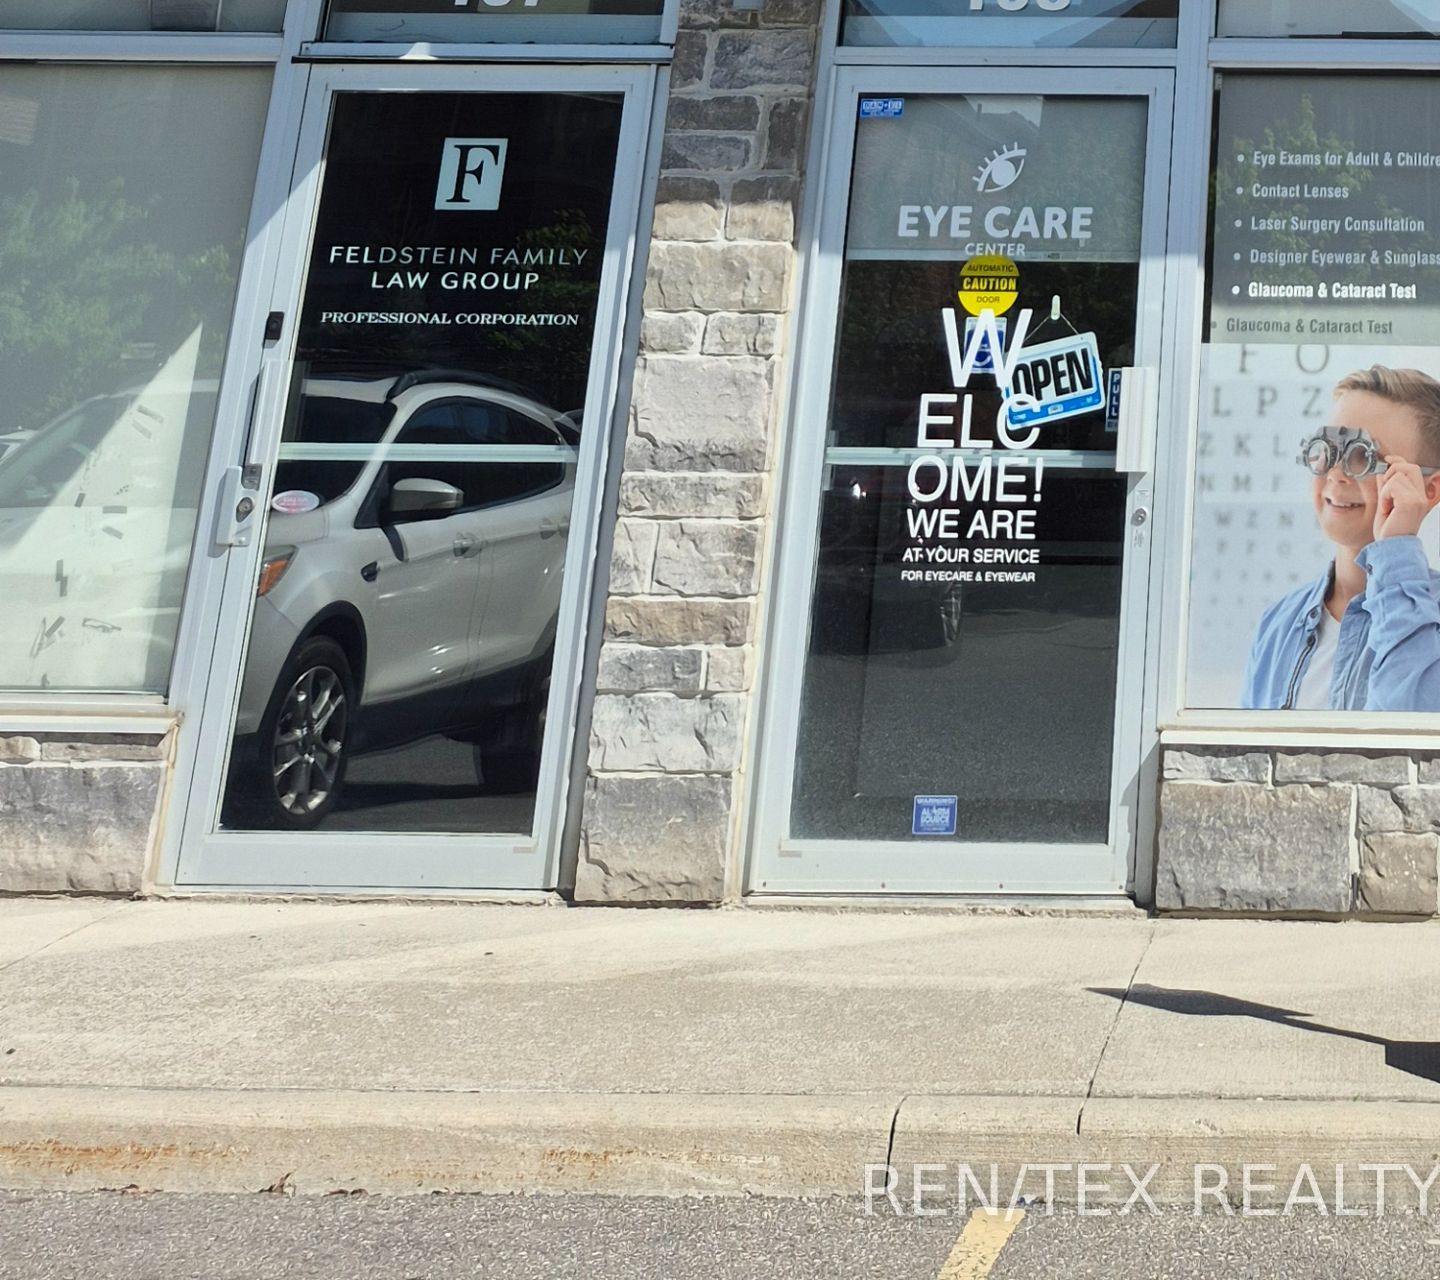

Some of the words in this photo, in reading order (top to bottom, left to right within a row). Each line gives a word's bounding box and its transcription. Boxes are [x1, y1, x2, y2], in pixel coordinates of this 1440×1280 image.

[1253, 152, 1275, 168] Eye
[1279, 152, 1321, 166] Exams
[1325, 152, 1341, 166] for
[1345, 152, 1379, 167] Adult
[1383, 153, 1392, 166] &
[446, 144, 499, 203] F
[1252, 184, 1300, 198] Contact
[1304, 184, 1349, 198] Lenses
[898, 205, 972, 238] EYE
[985, 206, 1093, 239] CARE
[1251, 217, 1286, 231] Laser
[1290, 217, 1340, 233] Surgery
[1344, 217, 1424, 232] Consultation
[329, 246, 477, 265] FELDSTEIN
[490, 248, 588, 266] FAMILY
[965, 243, 1026, 257] CENTER
[1250, 250, 1307, 266] Designer
[1312, 251, 1365, 267] Eyewear
[1370, 251, 1379, 265] &
[967, 264, 1014, 273] AUTOMATIC
[371, 272, 430, 289] LAW
[441, 272, 540, 290] GROUP
[963, 277, 1017, 290] CAUTION
[1248, 282, 1313, 298] Glaucoma
[1318, 283, 1327, 298] &
[1332, 283, 1386, 298] Cataract
[1390, 283, 1417, 299] Test
[976, 296, 1000, 304] DOOR
[321, 311, 451, 325] PROFESSIONAL
[455, 312, 579, 326] CORPORATION
[1012, 347, 1094, 401] OPEN
[907, 455, 1044, 502] OME!
[906, 509, 960, 538] WE
[966, 509, 1037, 539] ARE
[902, 548, 921, 562] AT
[925, 547, 969, 563] YOUR
[973, 548, 1040, 563] SERVICE
[901, 570, 922, 581] FOR
[925, 570, 973, 581] EYECARE
[975, 571, 982, 581] &
[984, 571, 1035, 582] EYEWEAR
